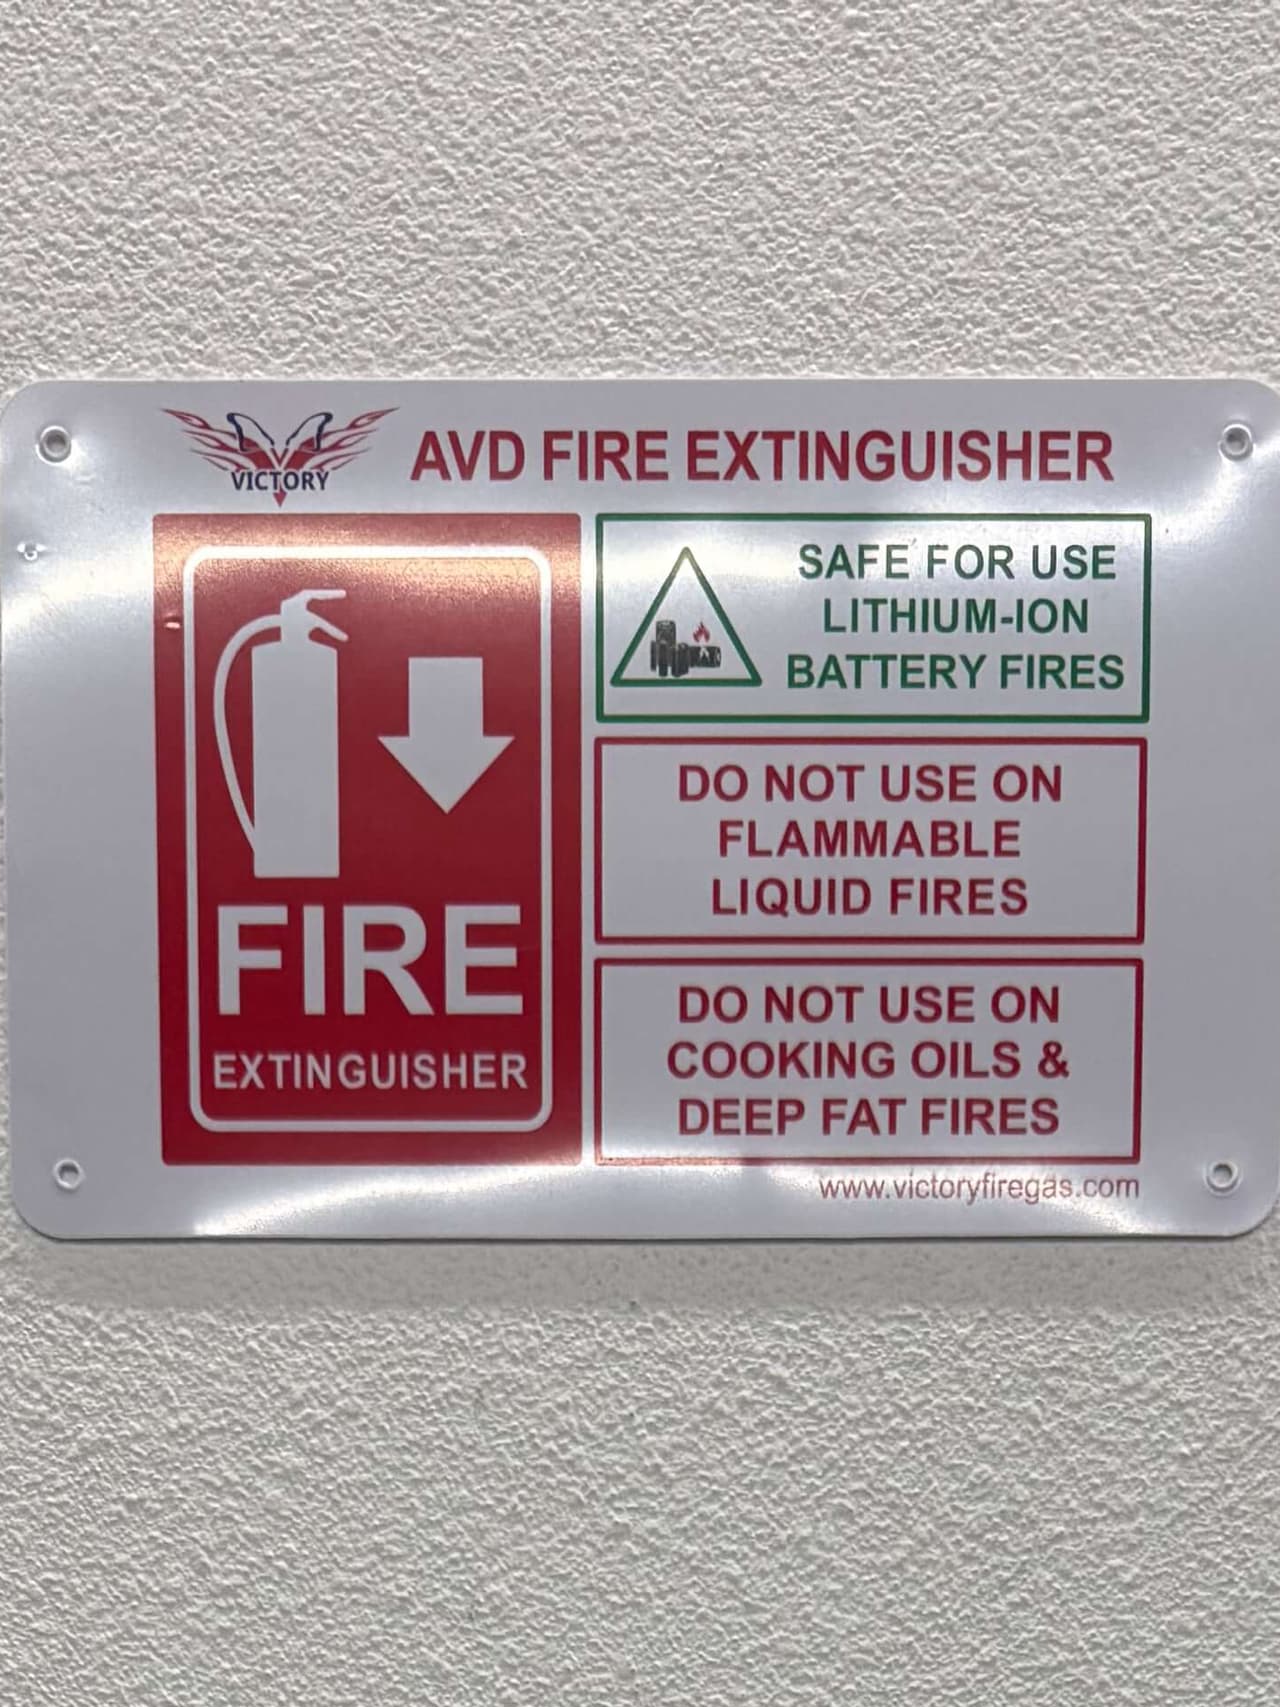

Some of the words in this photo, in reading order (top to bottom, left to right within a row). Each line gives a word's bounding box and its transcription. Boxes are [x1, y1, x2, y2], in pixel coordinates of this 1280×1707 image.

[410, 430, 525, 480] AVD
[543, 430, 668, 481] FIRE
[687, 430, 1114, 481] EXTINGUISHER
[231, 472, 328, 491] VICTORY
[799, 544, 909, 579] SAFE
[927, 544, 1015, 580] FOR
[1032, 545, 1116, 580] USE
[824, 598, 1088, 634] LITHIUM-ION
[788, 654, 987, 689] BATTERY
[1001, 654, 1124, 690] FIRES
[679, 764, 748, 802] DO
[765, 764, 865, 802] NOT
[881, 764, 976, 802] USE
[993, 764, 1061, 802] ON
[720, 820, 1020, 857] FLAMMABLE
[713, 878, 871, 918] LIQUID
[890, 878, 1027, 915] FIRES
[218, 904, 524, 1016] FIRE
[679, 985, 748, 1023] DO
[765, 985, 864, 1023] NOT
[880, 985, 974, 1023] USE
[991, 986, 1059, 1023] ON
[212, 1050, 528, 1094] EXTINGUISHER
[667, 1041, 895, 1079] COOKING
[911, 1041, 1021, 1078] OILS
[1038, 1040, 1069, 1078] &
[679, 1098, 805, 1135] DEEP
[822, 1098, 907, 1135] FAT
[922, 1097, 1059, 1135] FIRES
[818, 1170, 1141, 1205] www.victoryfiregas.com
